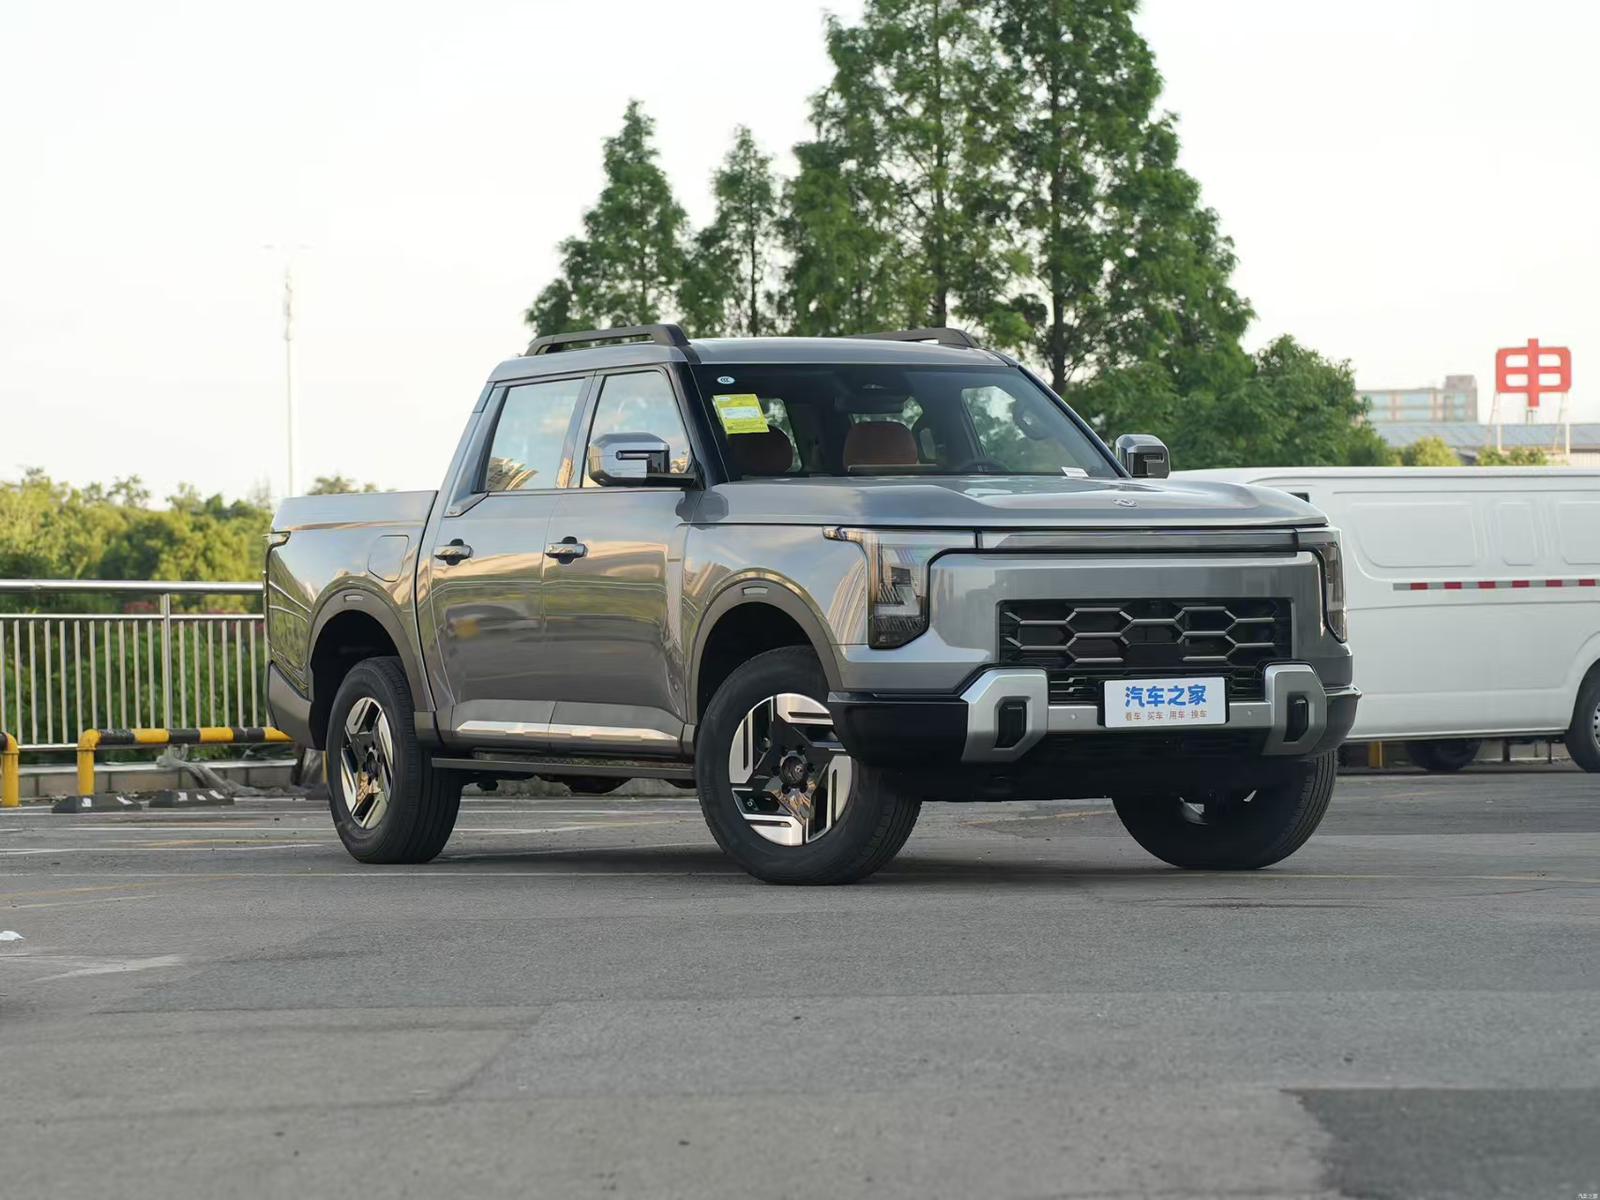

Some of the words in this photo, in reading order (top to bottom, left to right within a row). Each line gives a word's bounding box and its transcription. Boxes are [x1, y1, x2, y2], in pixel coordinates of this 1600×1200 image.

[1496, 338, 1571, 407] 申
[1125, 684, 1206, 708] 汽车之家
